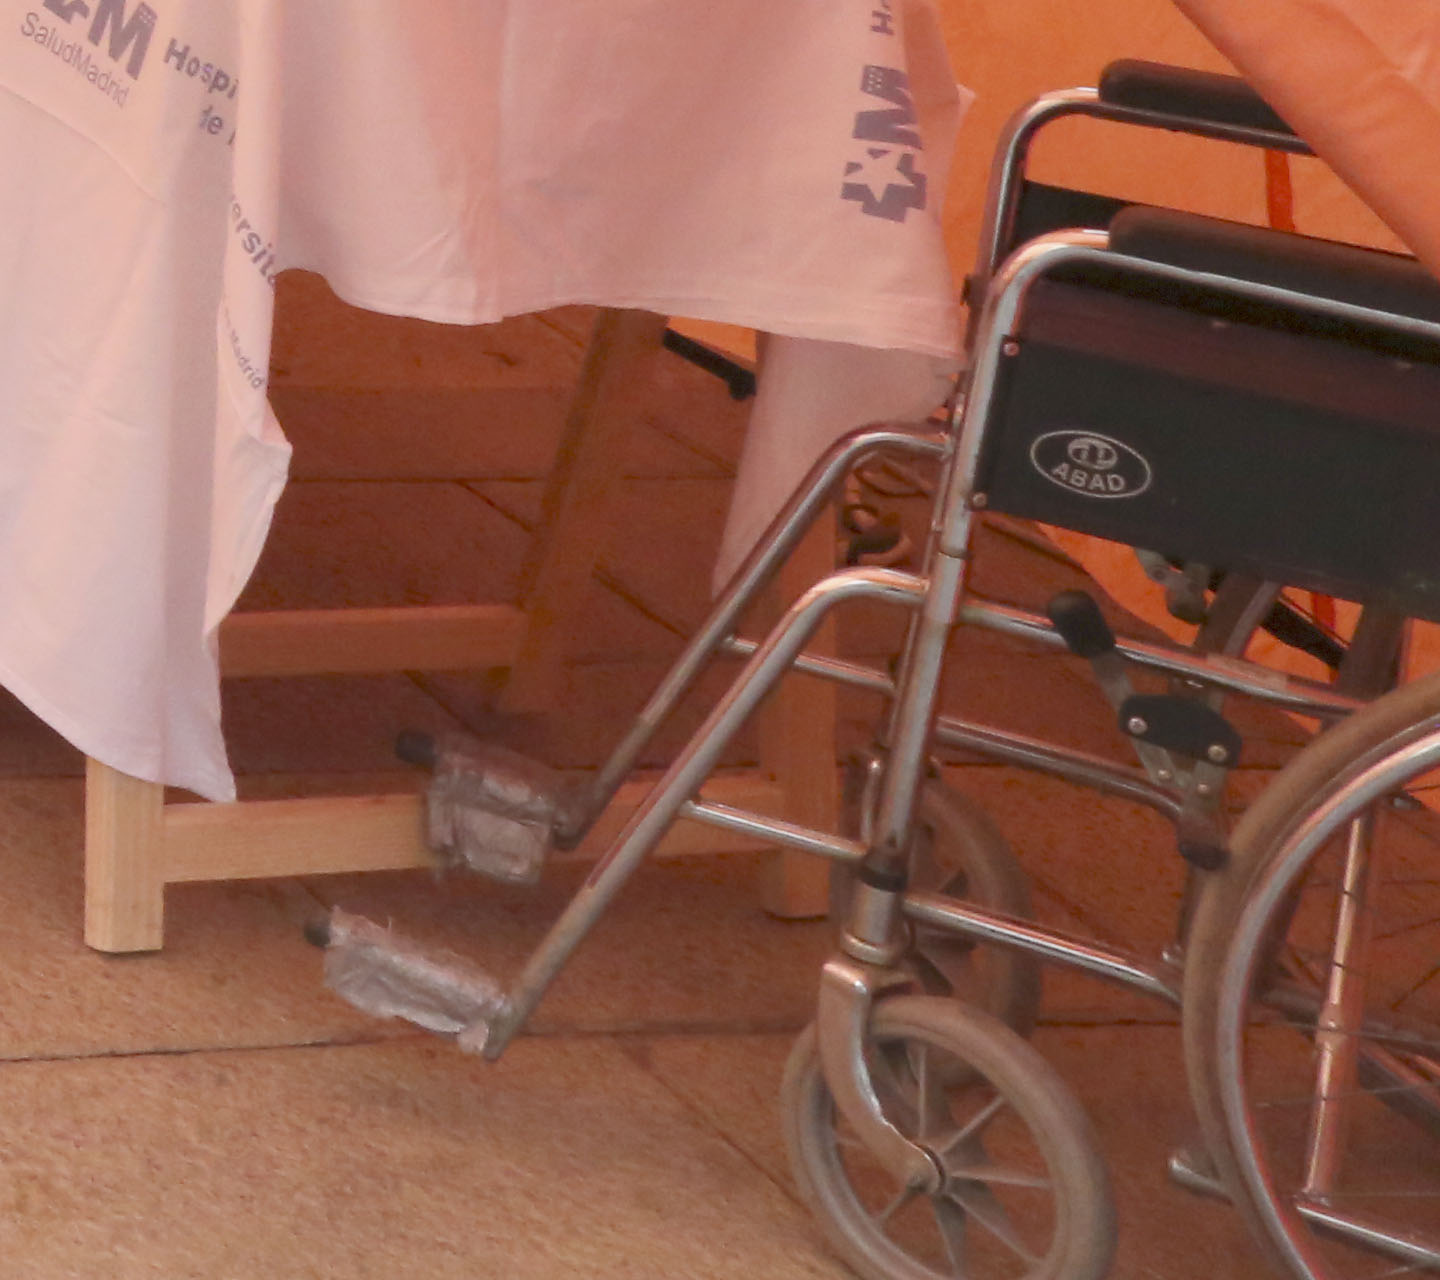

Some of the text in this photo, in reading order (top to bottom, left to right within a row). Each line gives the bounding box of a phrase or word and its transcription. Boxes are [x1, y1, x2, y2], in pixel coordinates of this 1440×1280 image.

[20, 11, 130, 110] SaludMadrid
[164, 37, 240, 99] Hospi
[1051, 461, 1126, 492] ABAD
